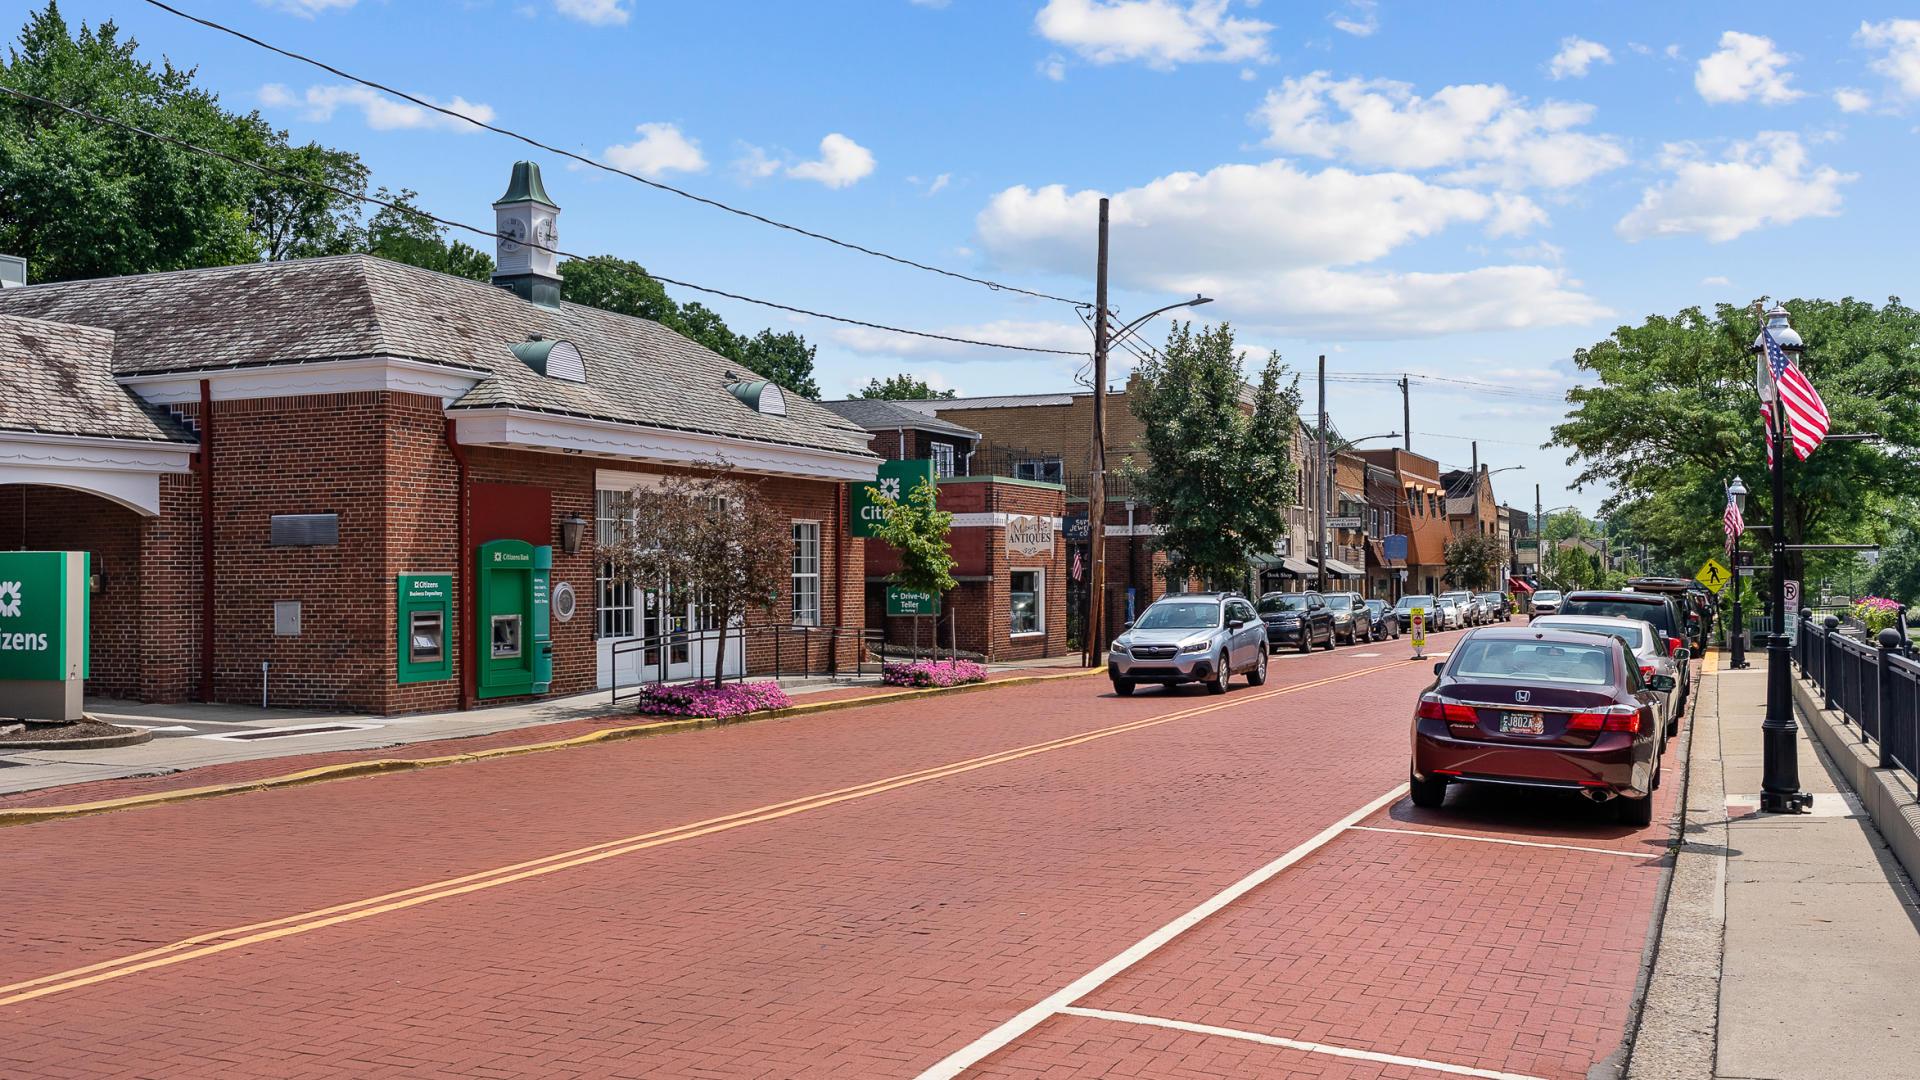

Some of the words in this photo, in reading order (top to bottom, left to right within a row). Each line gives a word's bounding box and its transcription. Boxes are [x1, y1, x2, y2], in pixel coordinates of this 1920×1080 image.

[1008, 532, 1051, 545] ANTIQUES
[900, 592, 930, 602] Drive-Up
[900, 601, 918, 609] Teller
